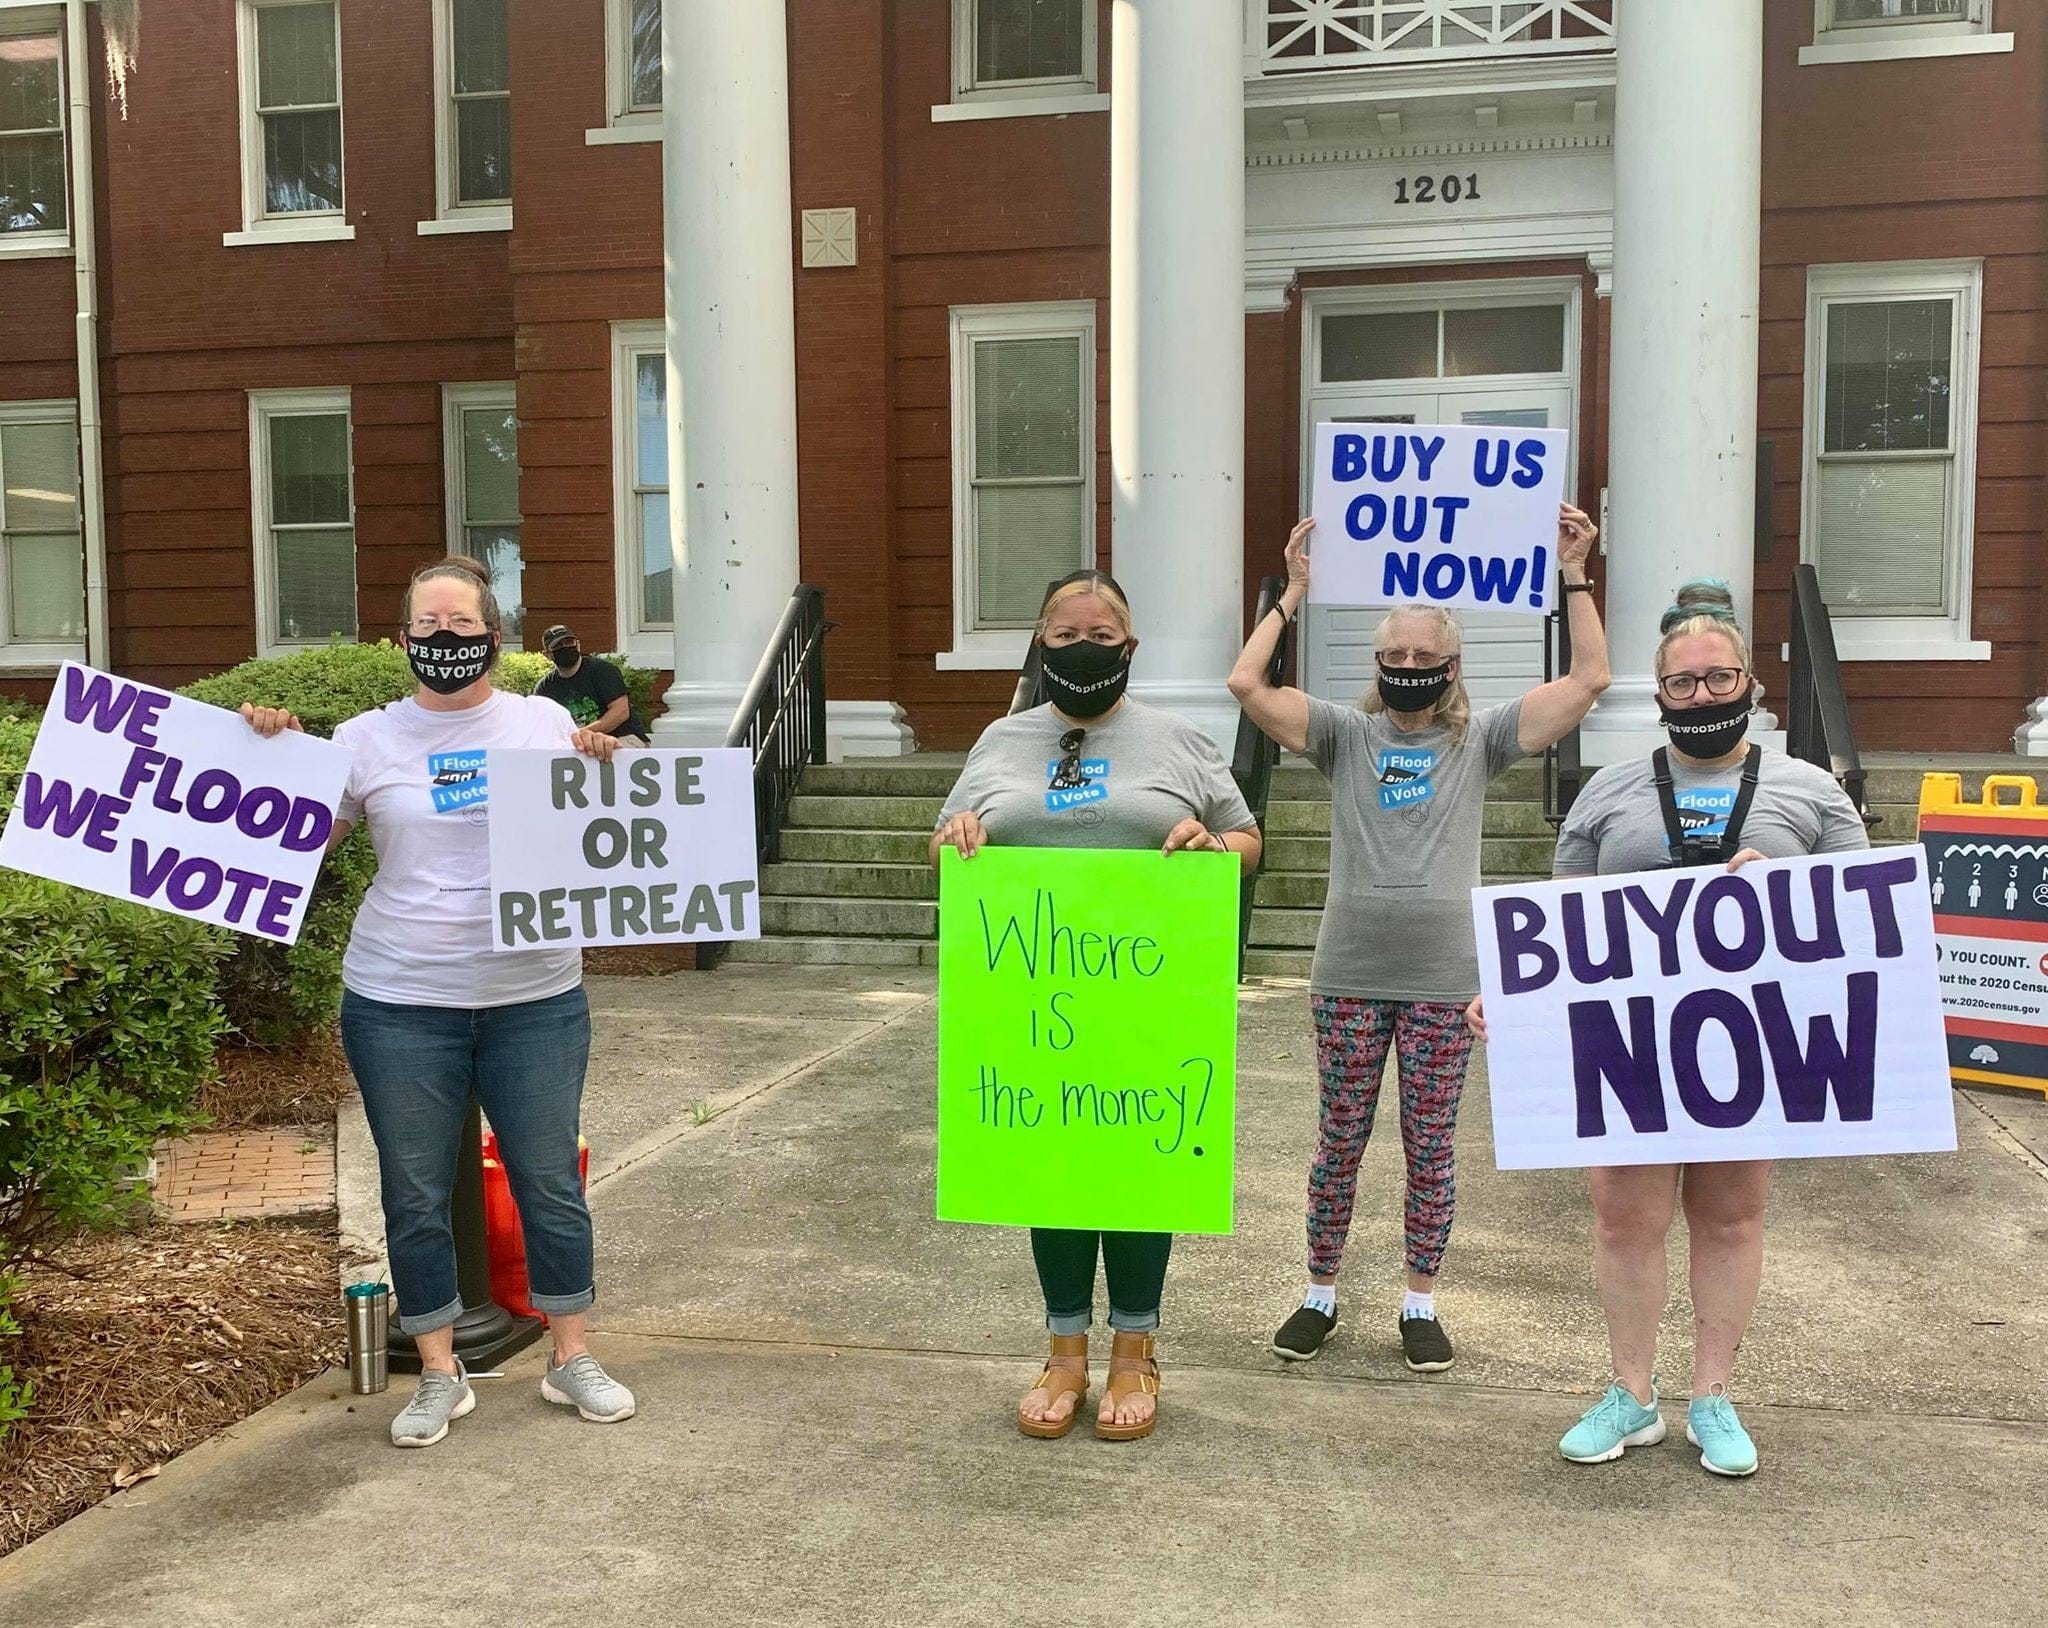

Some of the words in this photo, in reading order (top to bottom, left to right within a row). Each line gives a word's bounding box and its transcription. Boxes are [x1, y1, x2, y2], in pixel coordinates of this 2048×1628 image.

[1393, 173, 1481, 204] 1201
[1332, 434, 1445, 482] BUY
[1474, 439, 1546, 488] US
[1345, 493, 1469, 544] OUT
[1383, 545, 1546, 608] NOW!
[431, 645, 488, 661] FLOOD
[438, 662, 483, 679] VOTE
[64, 666, 171, 748] WE
[551, 757, 705, 810] RISE
[1382, 756, 1387, 768] I
[1391, 755, 1431, 768] Flood
[23, 772, 131, 853] WE
[119, 746, 333, 852] FLOOD
[439, 793, 446, 805] I
[448, 786, 488, 802] Vote
[1052, 795, 1058, 806] I
[1061, 789, 1100, 803] Vote
[1384, 791, 1390, 804] I
[1391, 785, 1426, 801] Vote
[1680, 793, 1731, 809] Flood
[582, 818, 668, 869] OR
[130, 838, 304, 938] VOTE
[1972, 863, 1982, 876] 2
[2008, 865, 2018, 879] 3
[499, 880, 755, 946] RETREAT
[978, 888, 1165, 980] Where
[1492, 856, 1918, 996] BUYOUT
[1950, 950, 1977, 964] YOU
[1980, 953, 2031, 969] COUNT.
[1957, 974, 1977, 986] the
[1980, 976, 2010, 990] 2020
[1567, 971, 1879, 1139] NOW
[969, 1064, 1044, 1129] the
[1061, 1057, 1214, 1158] money?
